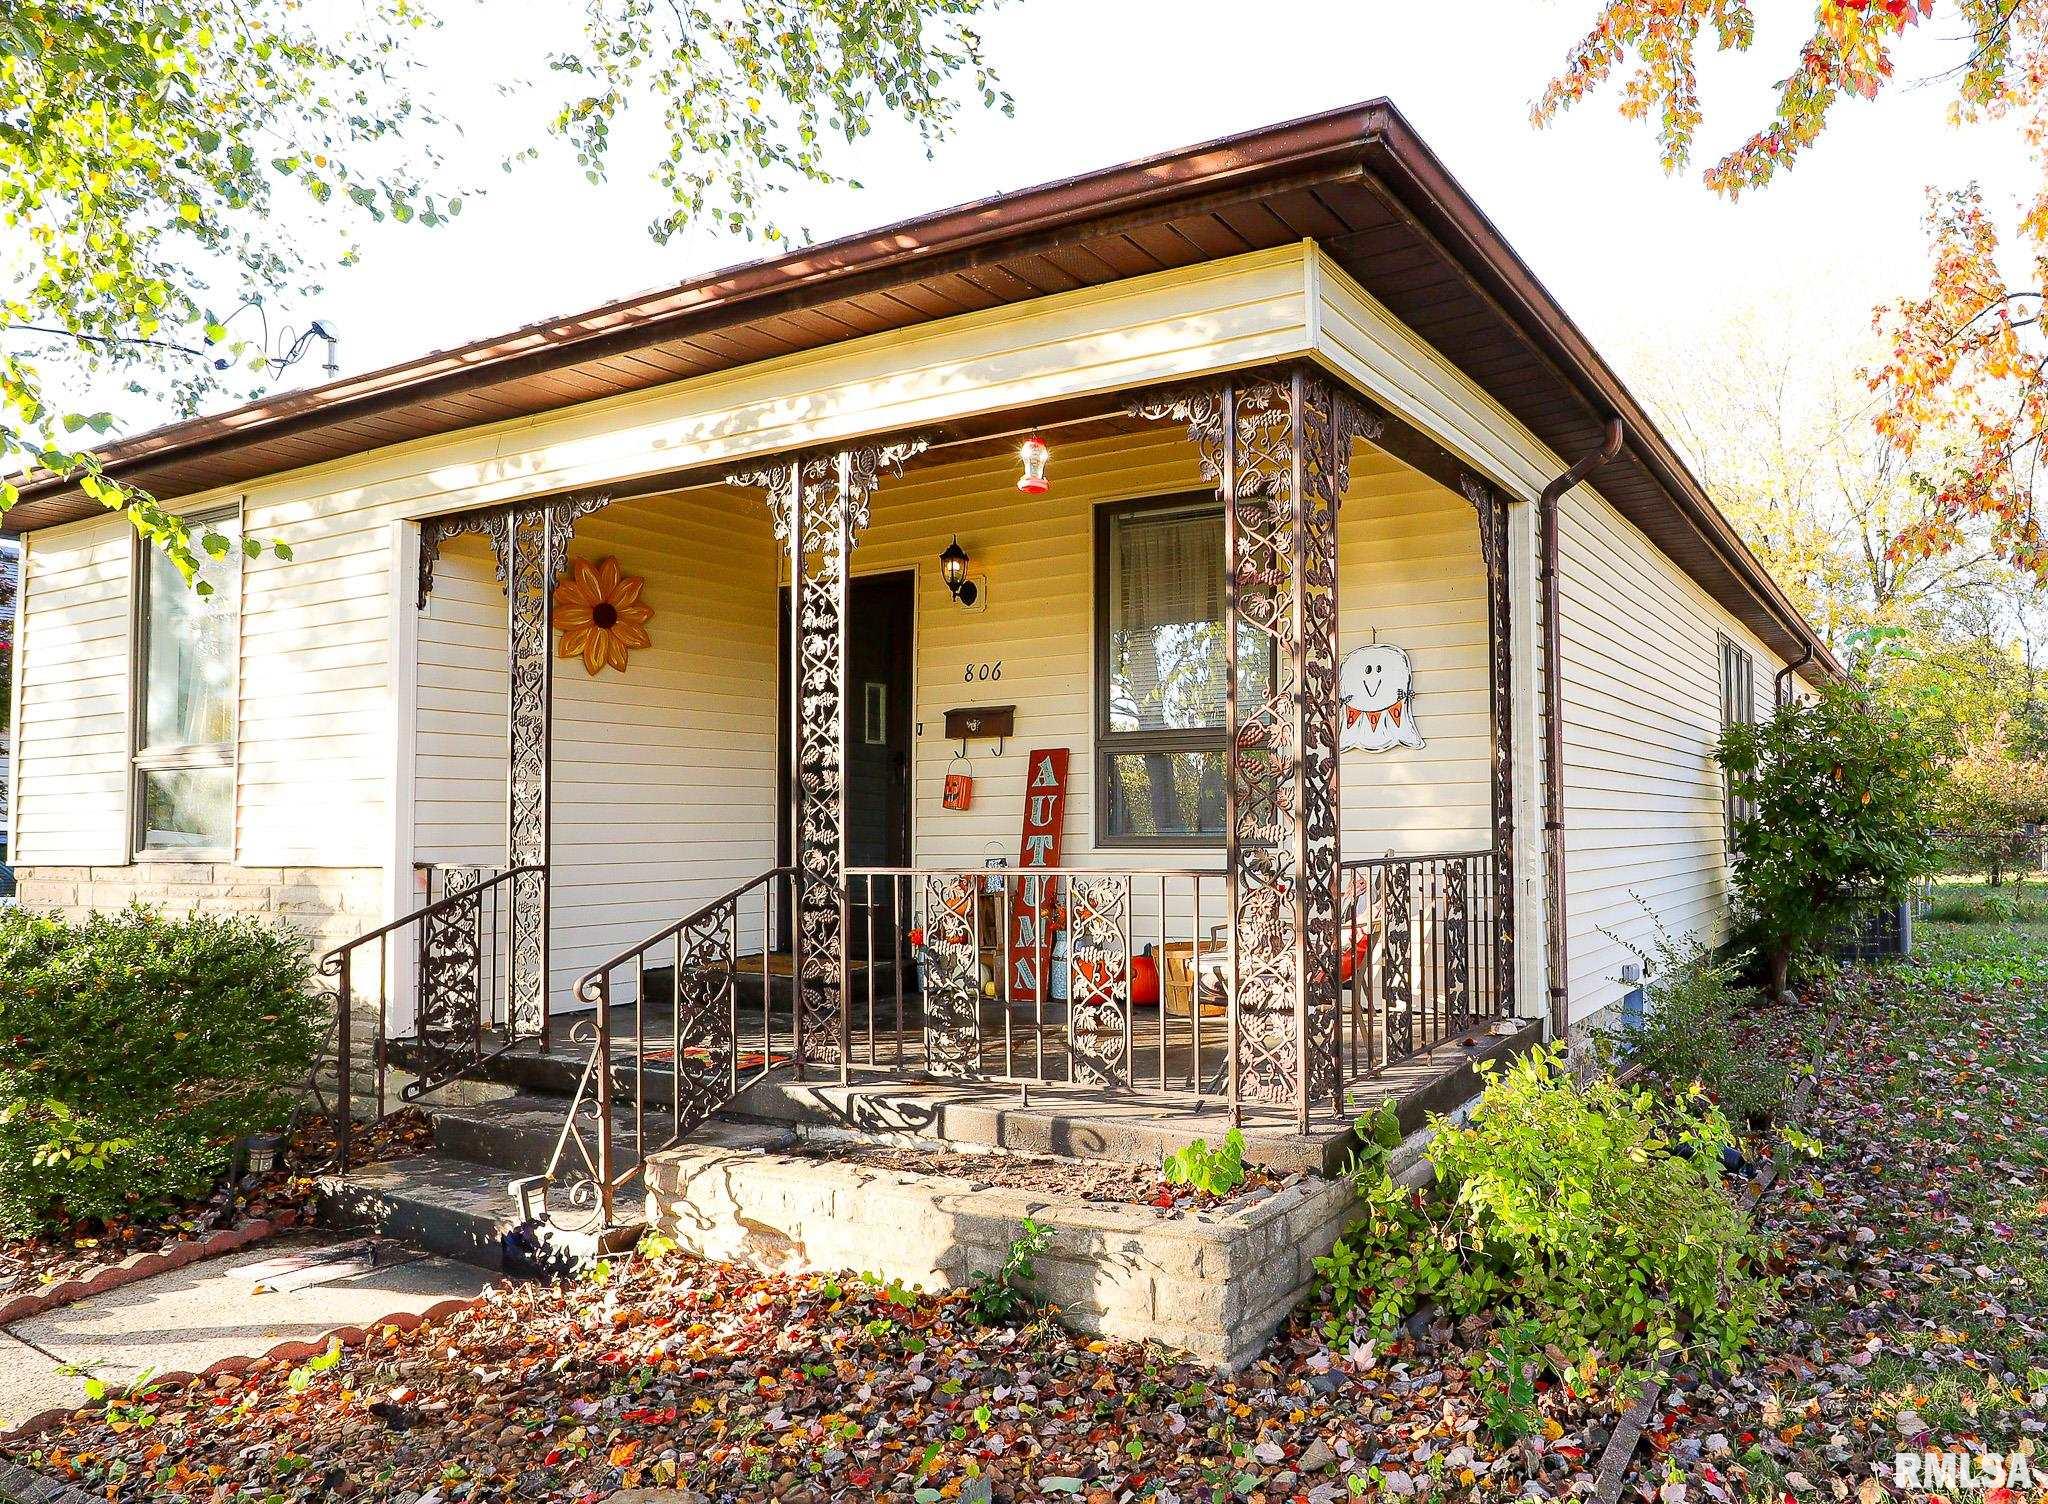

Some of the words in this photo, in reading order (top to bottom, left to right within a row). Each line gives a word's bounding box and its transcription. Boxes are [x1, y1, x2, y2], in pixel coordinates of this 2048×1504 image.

[964, 660, 1002, 682] 806
[1347, 707, 1402, 726] BOO
[1014, 755, 1059, 989] AUTUMN
